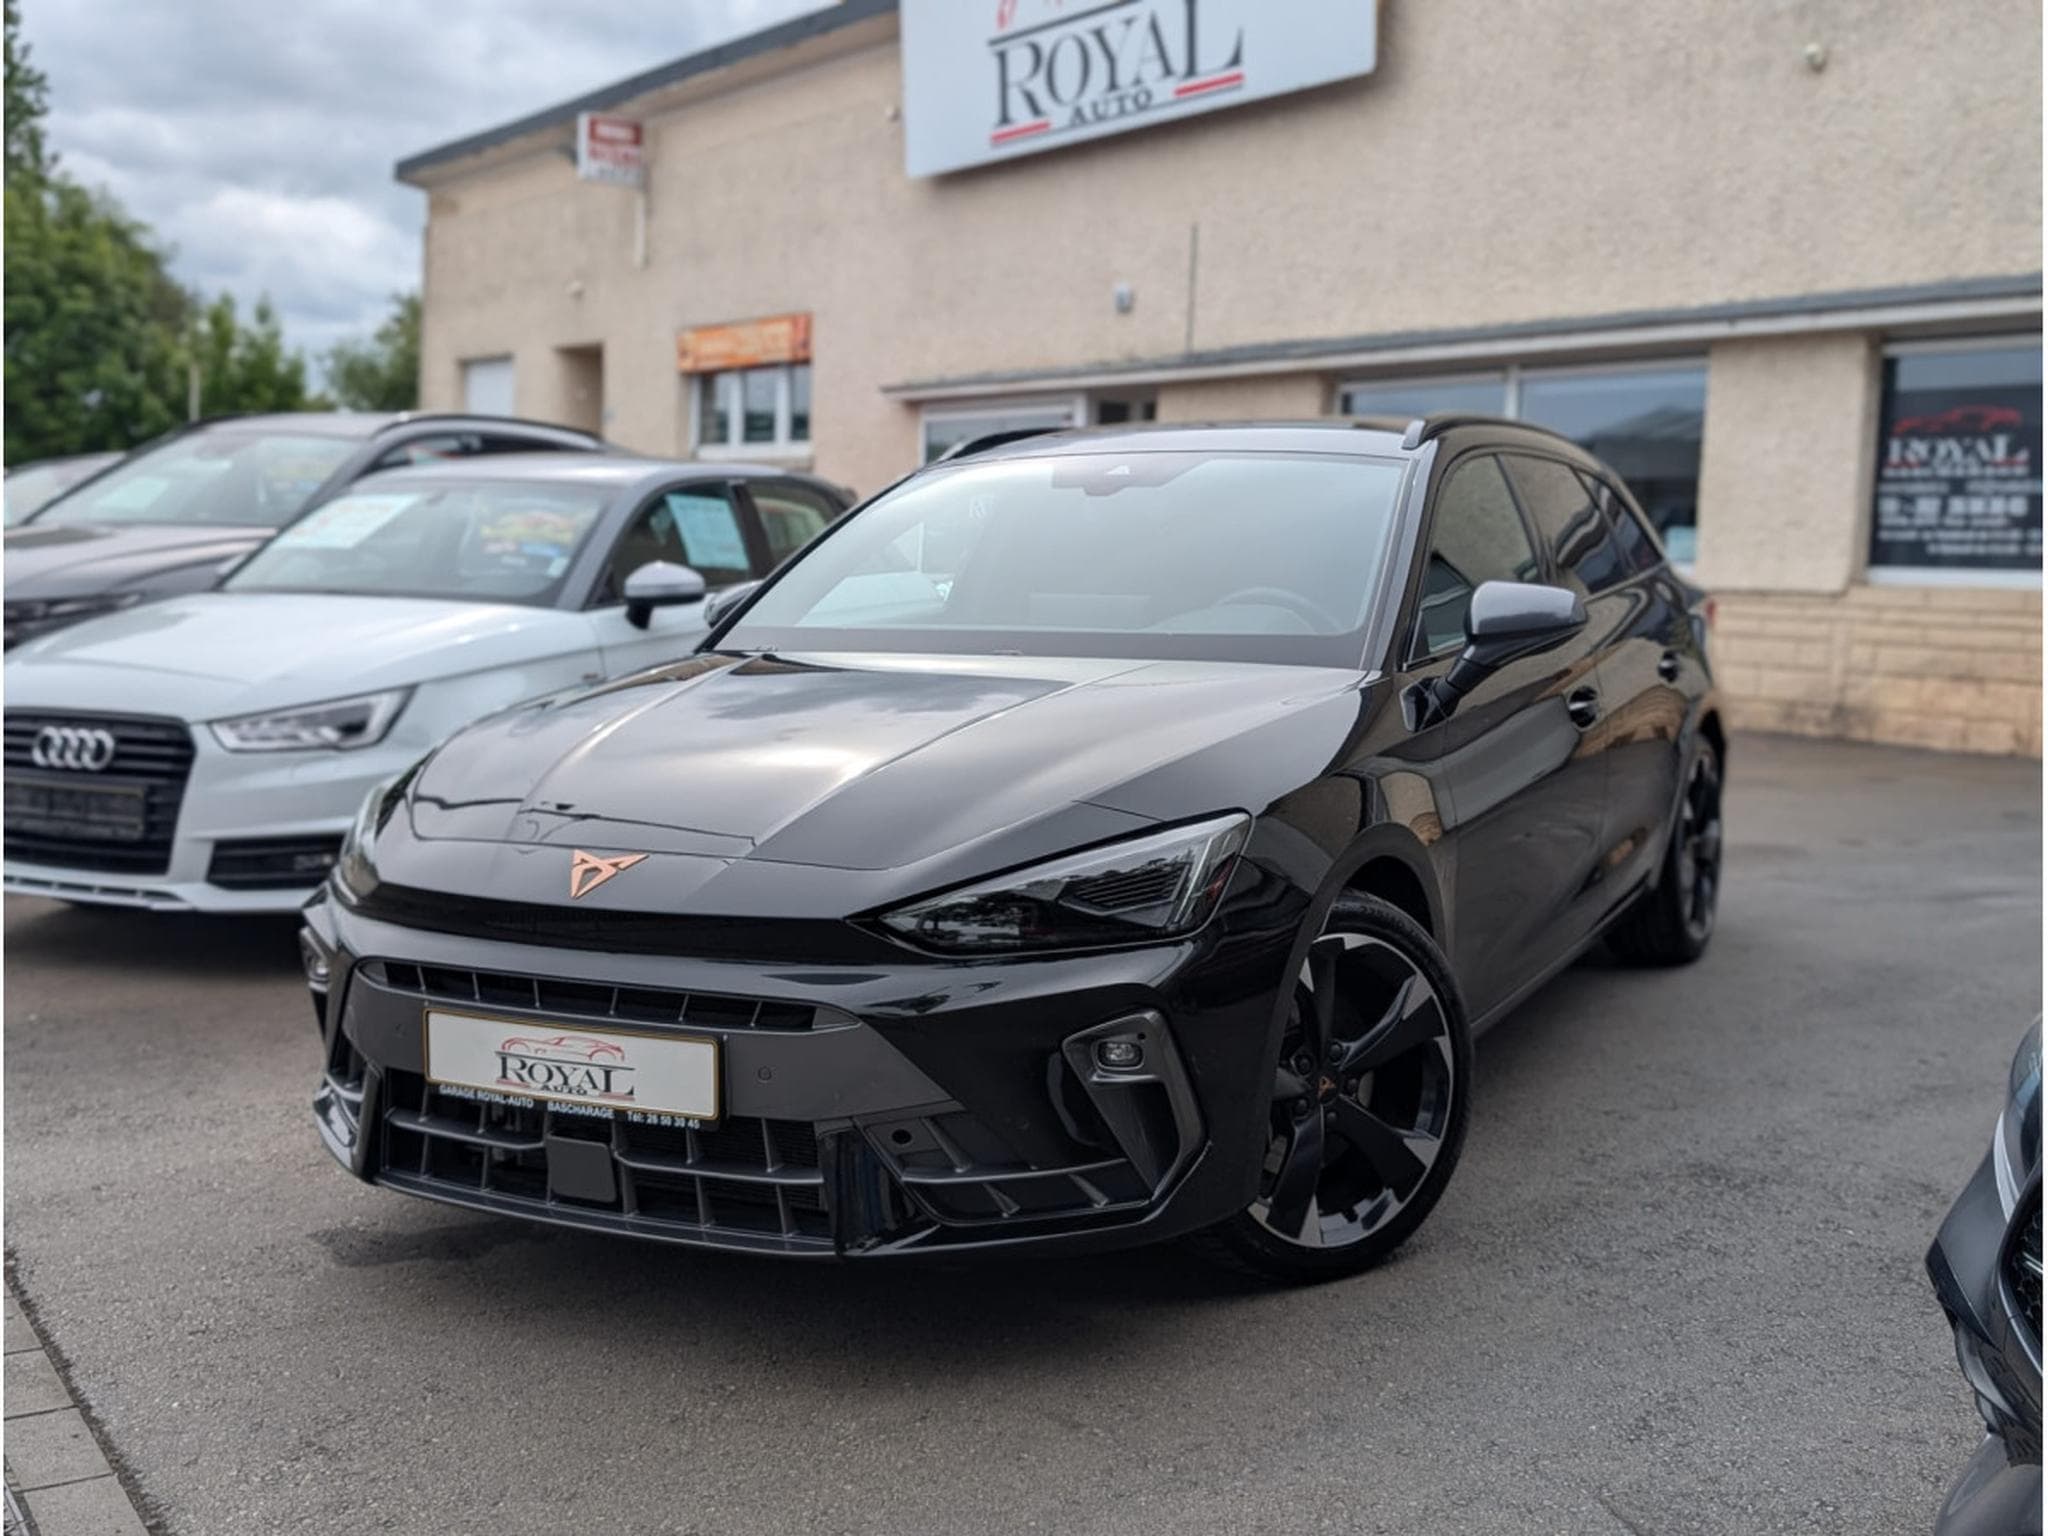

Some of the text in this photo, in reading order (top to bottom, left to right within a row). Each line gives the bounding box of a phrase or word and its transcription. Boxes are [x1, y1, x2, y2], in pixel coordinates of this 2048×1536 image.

[992, 0, 1244, 127] ROYAL
[1069, 89, 1153, 127] AUTO
[499, 1055, 634, 1096] ROYAL
[541, 1083, 588, 1097] AUTO
[439, 1084, 475, 1100] GARAGE
[476, 1089, 534, 1109] ROYAL-AUTO
[547, 1101, 615, 1120] BASCHARAGE
